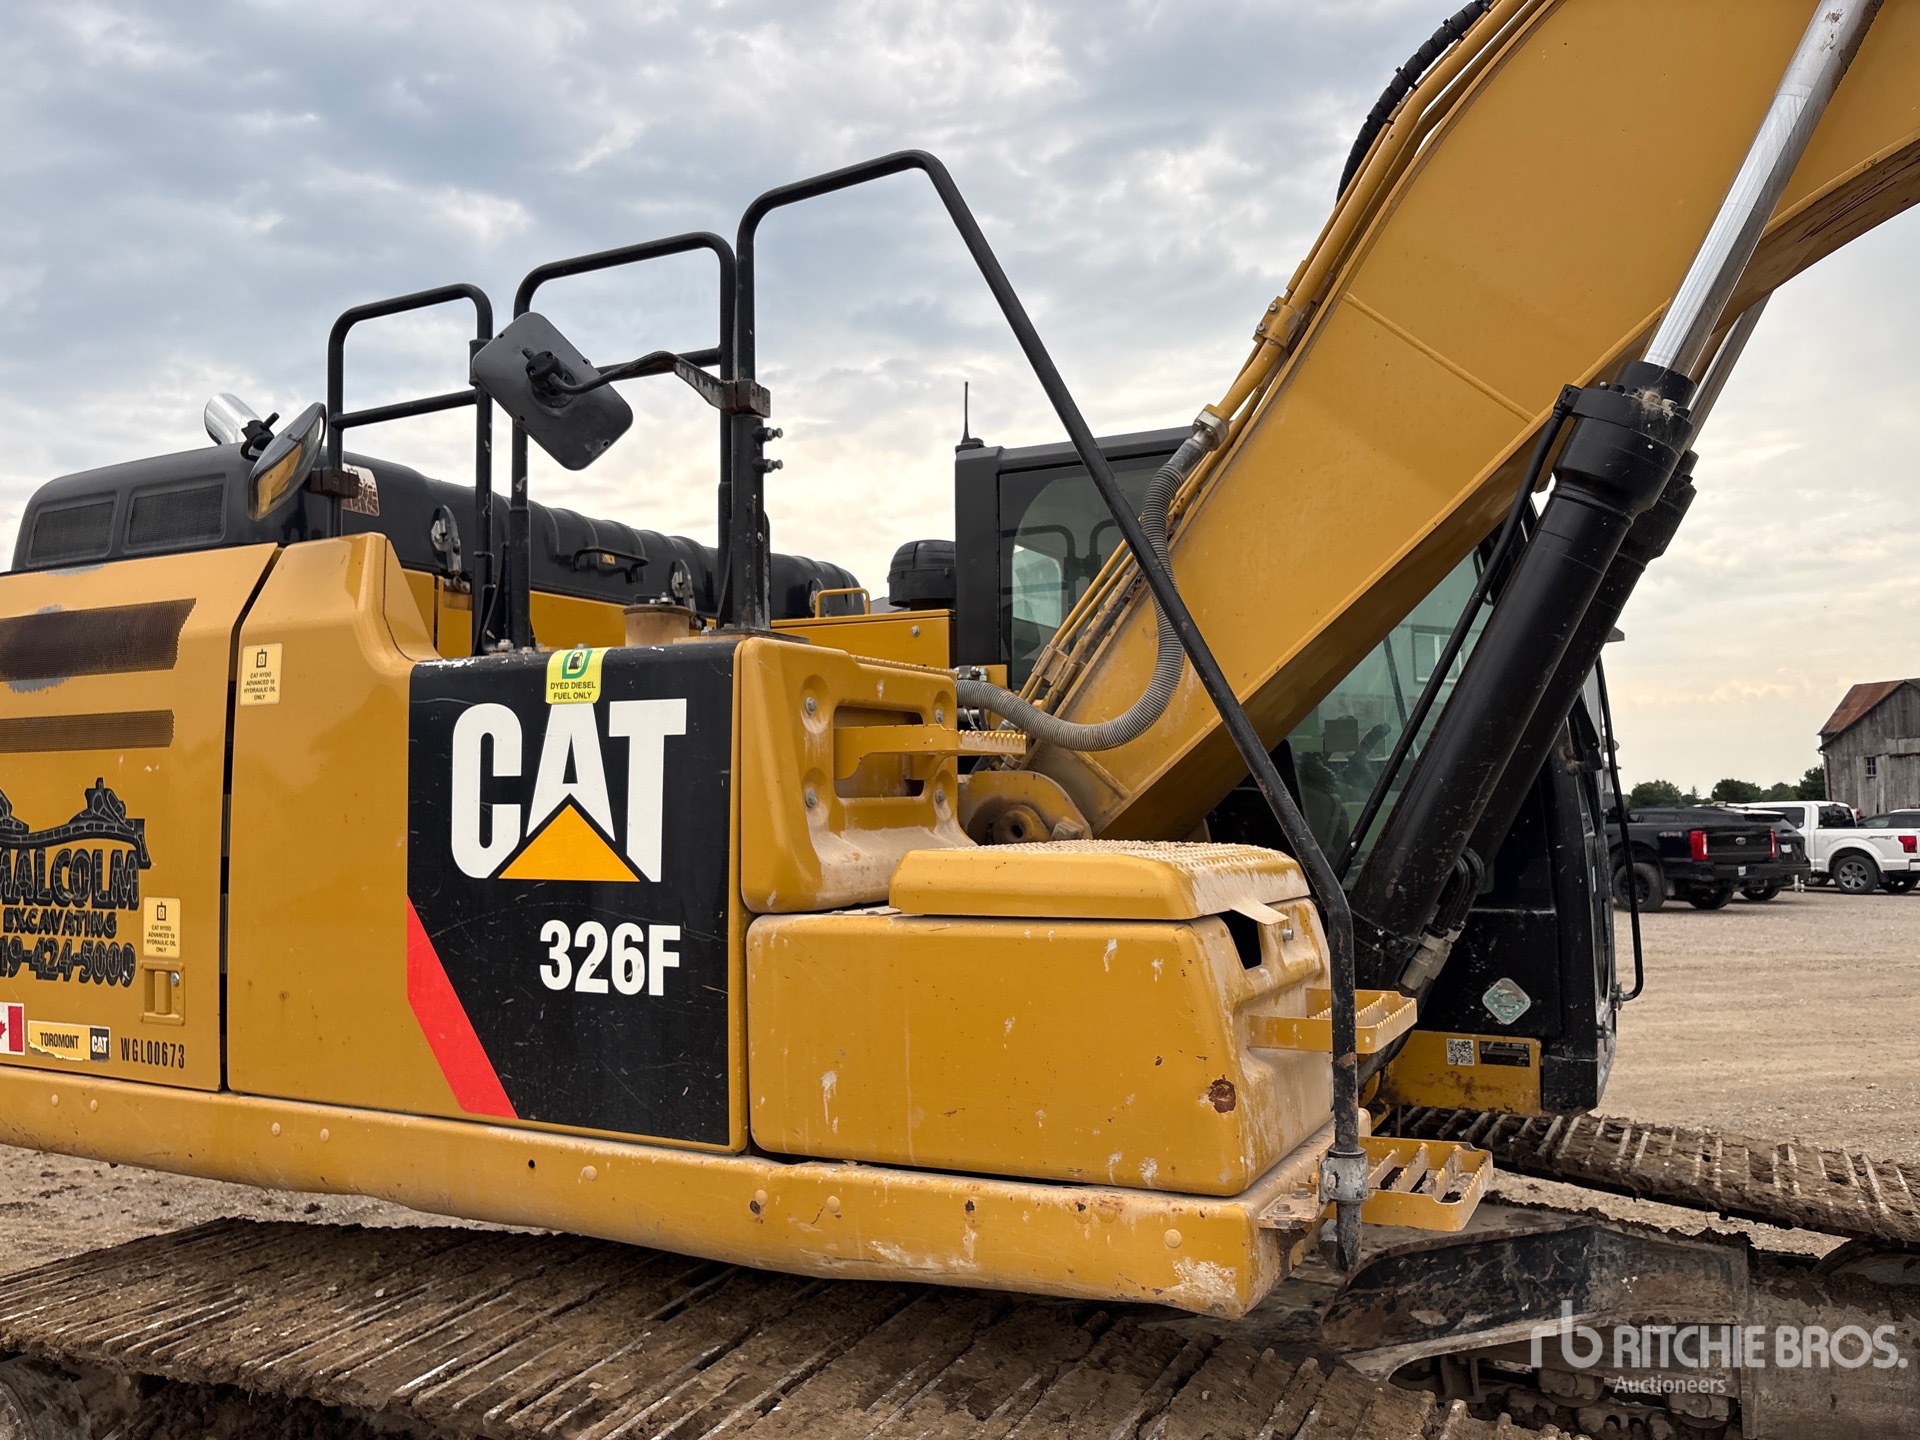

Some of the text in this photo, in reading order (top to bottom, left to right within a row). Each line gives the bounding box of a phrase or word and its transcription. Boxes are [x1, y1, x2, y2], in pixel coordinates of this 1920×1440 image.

[571, 681, 596, 689] DIESEL
[451, 698, 687, 883] CAT
[3, 907, 117, 939] EXCAVATING
[539, 919, 681, 996] 326F
[40, 1032, 108, 1054] TOROMONT CAT
[121, 1037, 185, 1069] WGL00673
